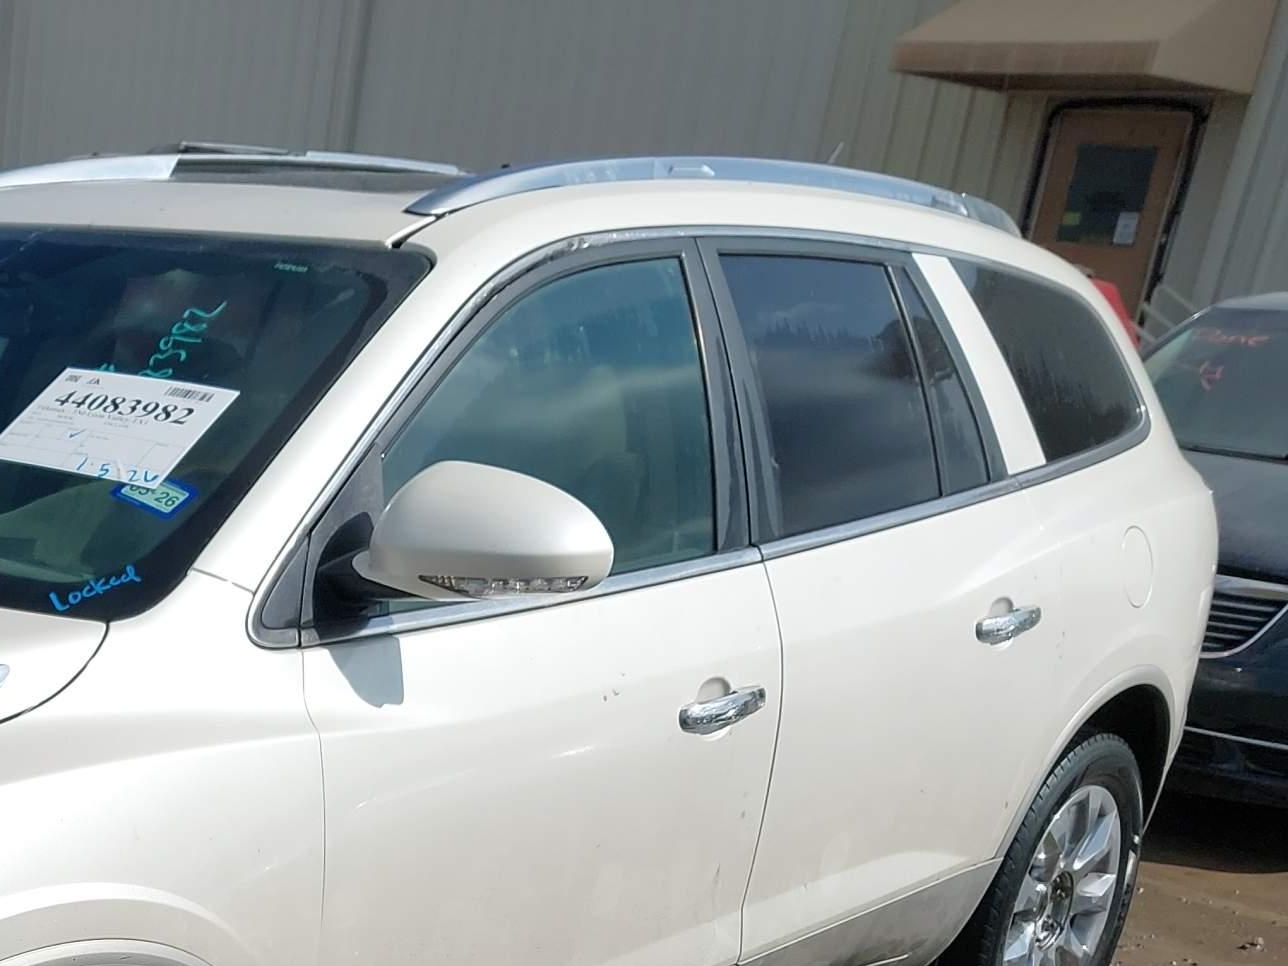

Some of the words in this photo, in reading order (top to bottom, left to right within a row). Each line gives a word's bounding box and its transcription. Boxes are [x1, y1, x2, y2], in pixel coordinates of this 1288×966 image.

[54, 389, 195, 425] 44083982
[154, 491, 180, 507] 26
[48, 564, 142, 612] Locked
